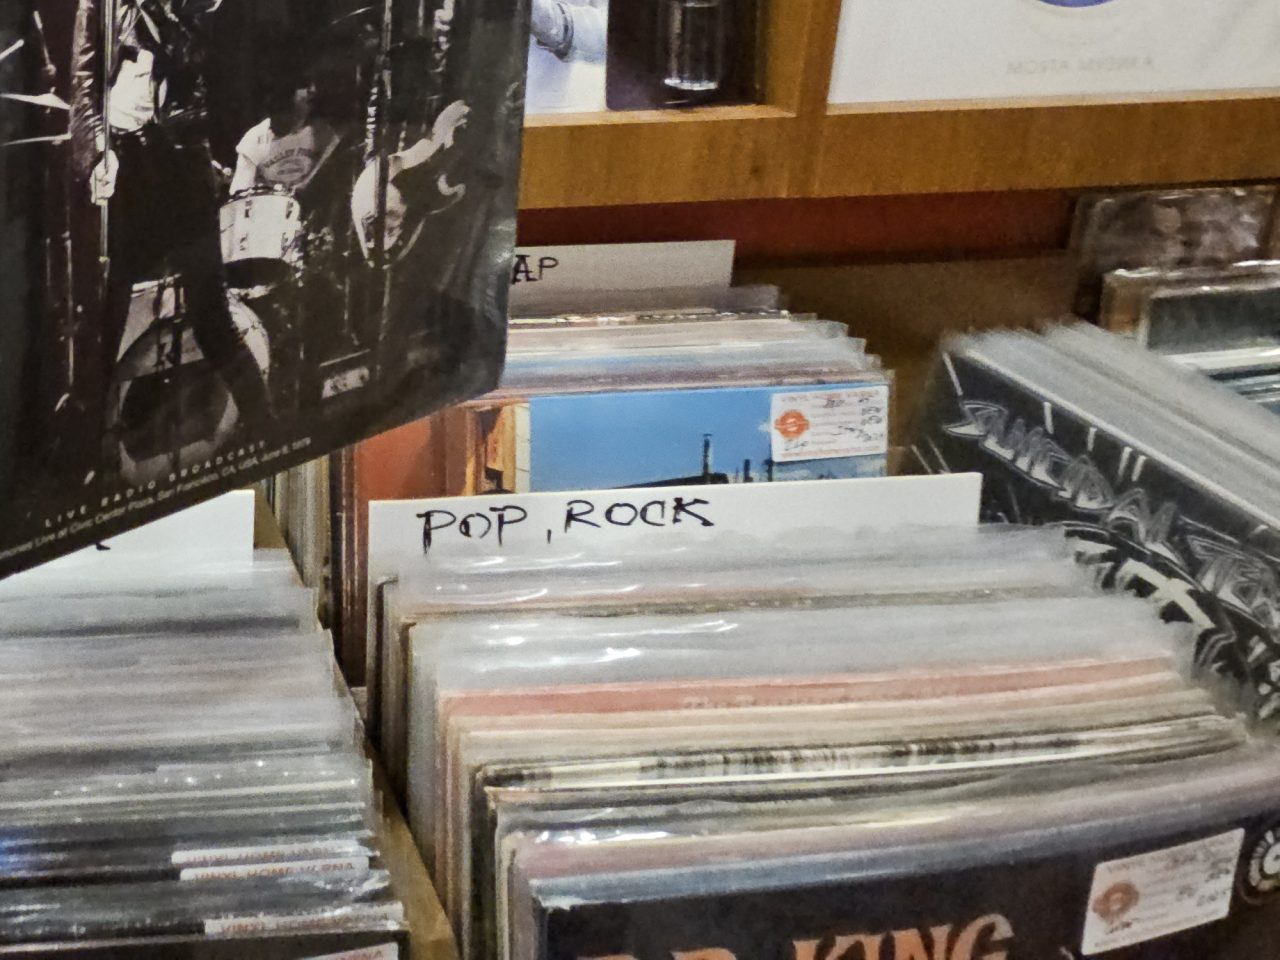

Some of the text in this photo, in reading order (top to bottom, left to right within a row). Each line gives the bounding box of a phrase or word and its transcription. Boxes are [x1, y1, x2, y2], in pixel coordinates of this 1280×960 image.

[44, 440, 266, 529] LIVE RADIO BROADCAST
[564, 496, 715, 534] ROCK
